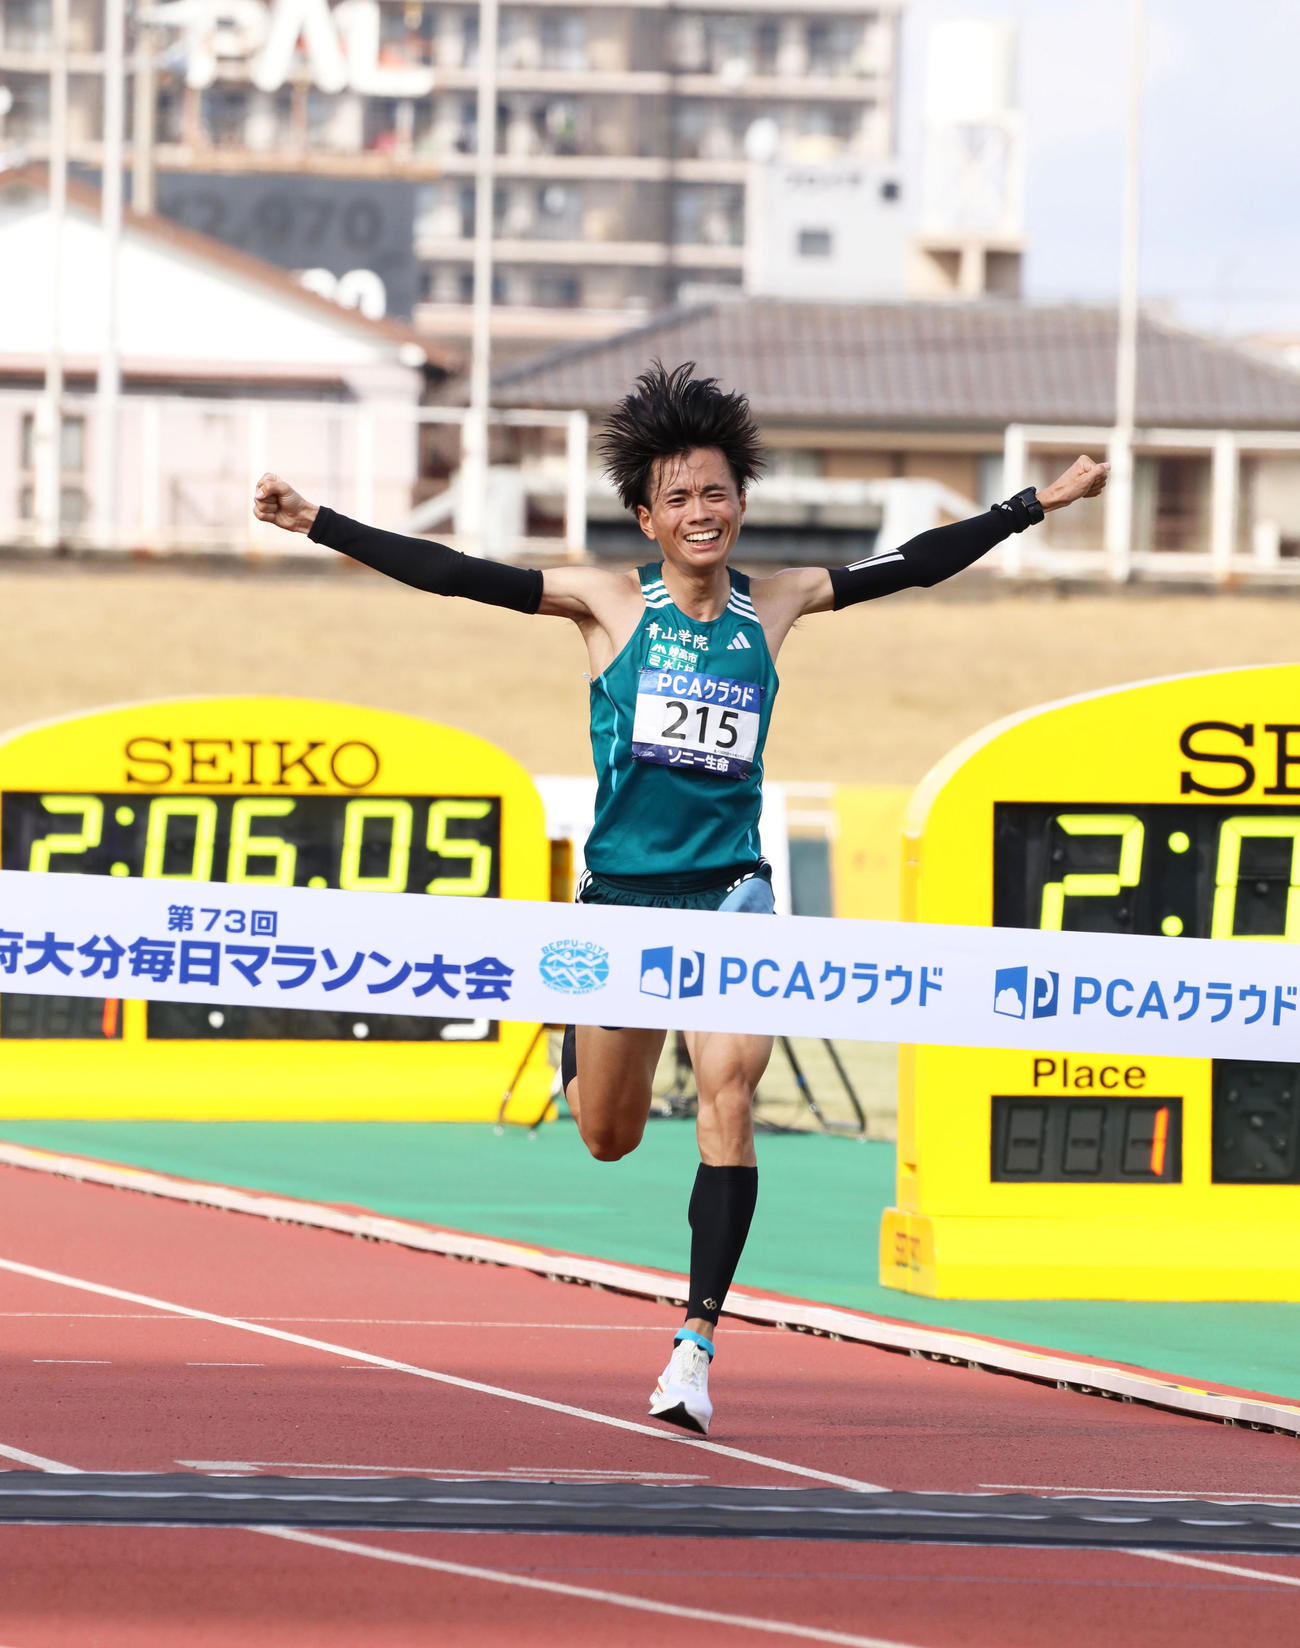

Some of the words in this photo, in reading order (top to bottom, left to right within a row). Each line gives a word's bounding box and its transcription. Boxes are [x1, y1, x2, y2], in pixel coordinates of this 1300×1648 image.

[645, 622, 710, 651] 青山学院
[656, 673, 755, 708] PCAクラウド
[660, 700, 740, 749] 215
[125, 737, 381, 790] SEIKO
[668, 748, 730, 773] ソニー生命
[167, 904, 279, 938] 第73回
[718, 956, 944, 1007] PCAクラウド
[1071, 976, 1298, 1026] PCAクラウド
[1032, 1057, 1147, 1090] Place
[1150, 1106, 1170, 1177] 1
